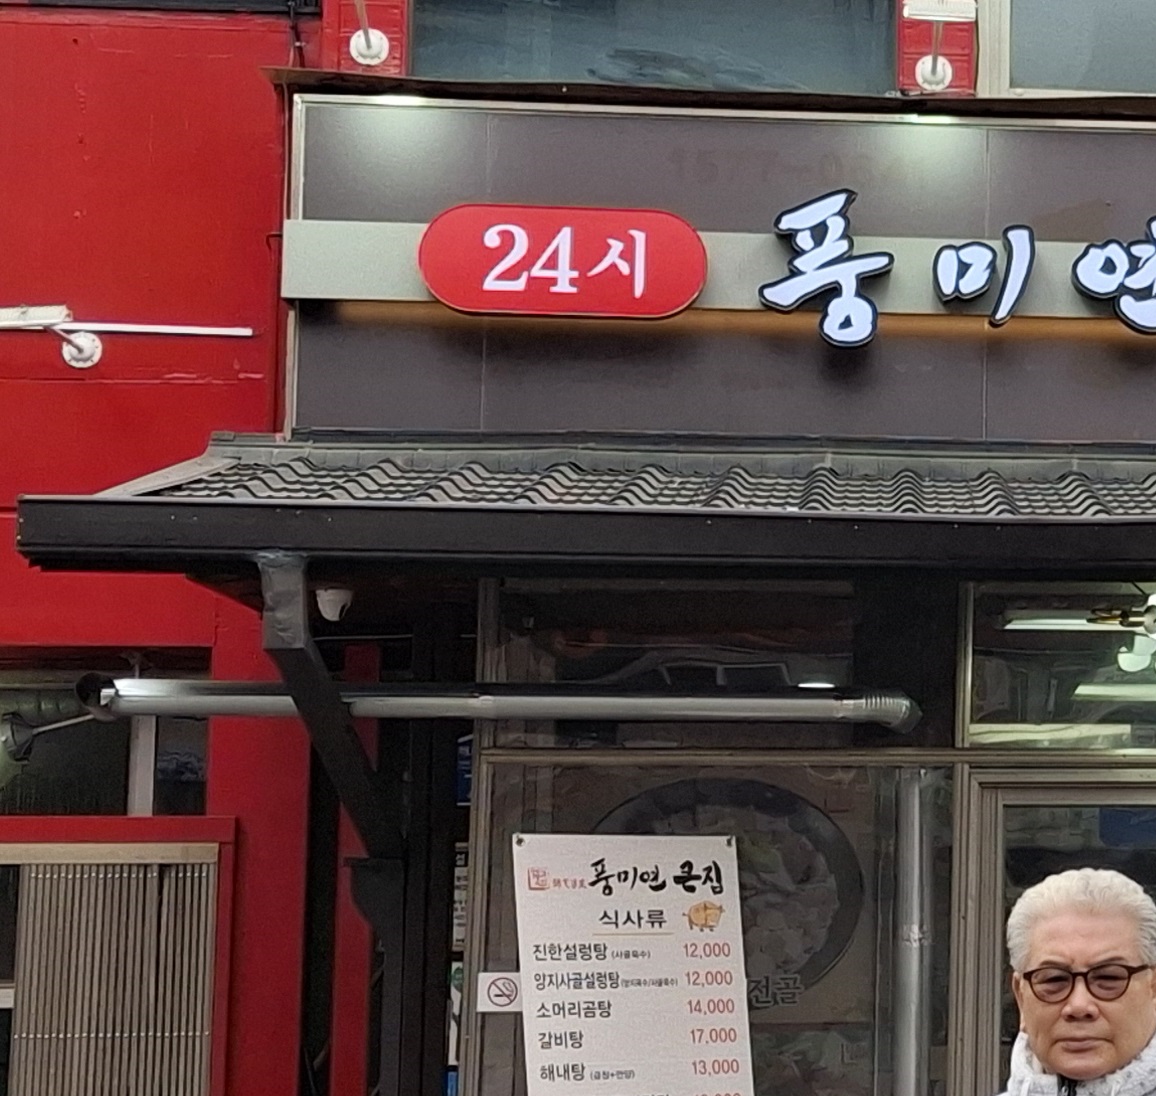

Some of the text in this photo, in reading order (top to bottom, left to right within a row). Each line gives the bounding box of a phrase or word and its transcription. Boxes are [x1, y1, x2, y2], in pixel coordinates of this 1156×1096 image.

[482, 224, 648, 300] 24시
[588, 857, 667, 897] 풍미연
[673, 860, 724, 895] 큰집
[598, 909, 668, 929] 식사류
[533, 942, 608, 961] 진한설렁탕
[683, 942, 731, 960] 12,000
[685, 970, 733, 988] 12,000
[536, 998, 735, 1019] 소머리곰탕 14,000
[538, 1027, 737, 1049] 갈비탕 17,000
[539, 1063, 586, 1081] 해내탕
[692, 1059, 740, 1077] 13,000
